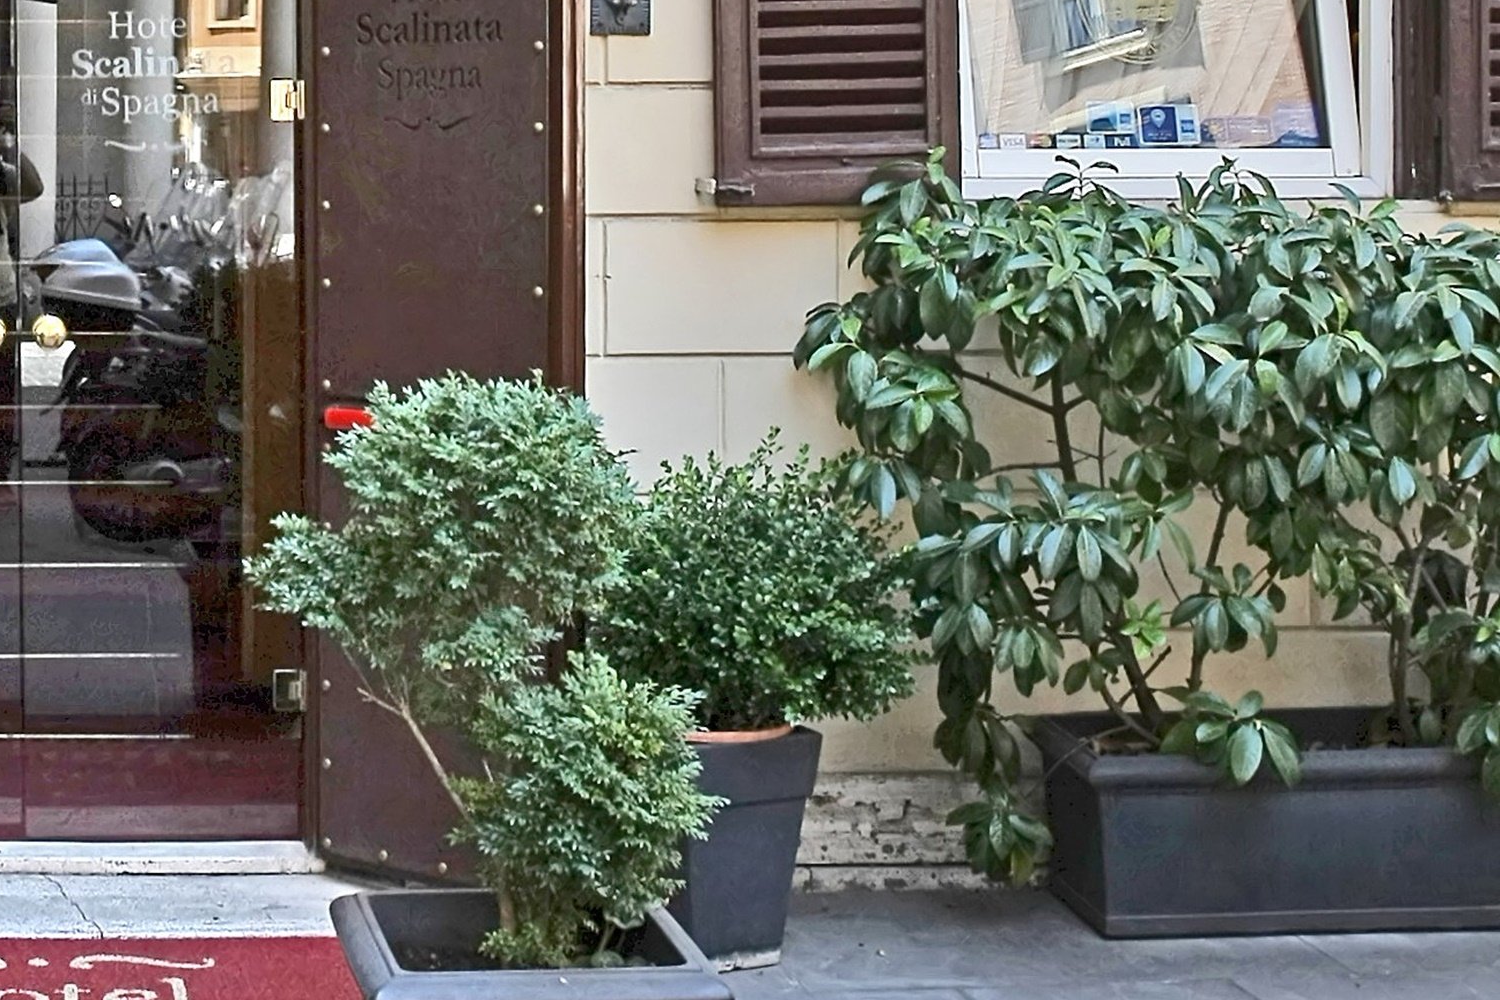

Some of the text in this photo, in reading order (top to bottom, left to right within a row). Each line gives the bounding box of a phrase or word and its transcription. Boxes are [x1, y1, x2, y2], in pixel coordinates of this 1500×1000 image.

[108, 9, 190, 40] Hote
[357, 12, 503, 45] Scalinata
[71, 46, 235, 79] Scalina
[378, 58, 482, 101] Spagna
[81, 86, 220, 124] di Spagna
